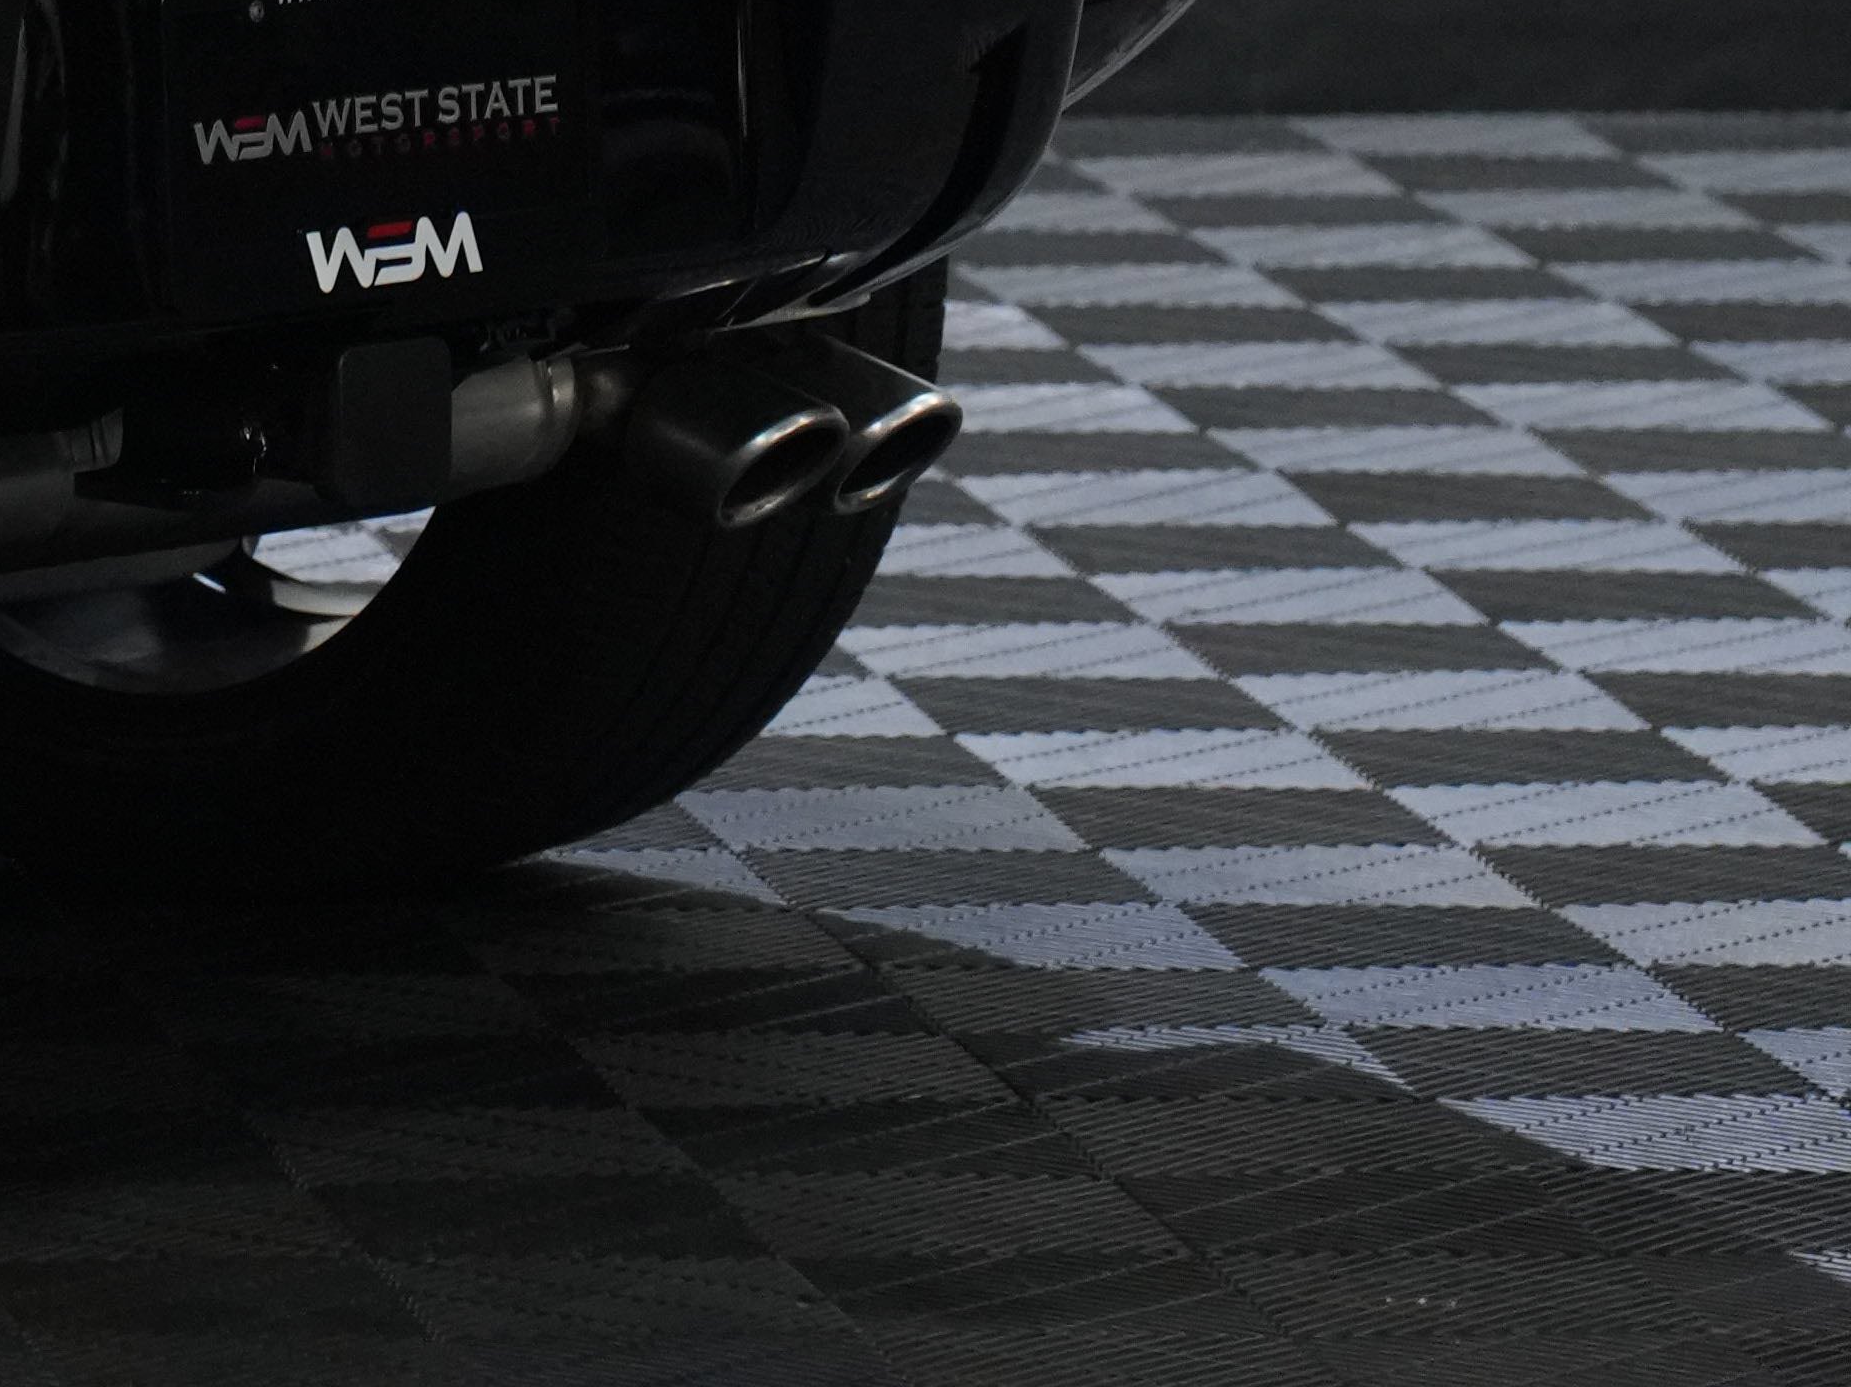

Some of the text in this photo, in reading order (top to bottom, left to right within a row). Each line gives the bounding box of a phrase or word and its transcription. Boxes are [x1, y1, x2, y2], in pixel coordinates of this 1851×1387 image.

[312, 88, 429, 138] WEST
[438, 73, 558, 124] STATE
[305, 211, 484, 294] WSM
